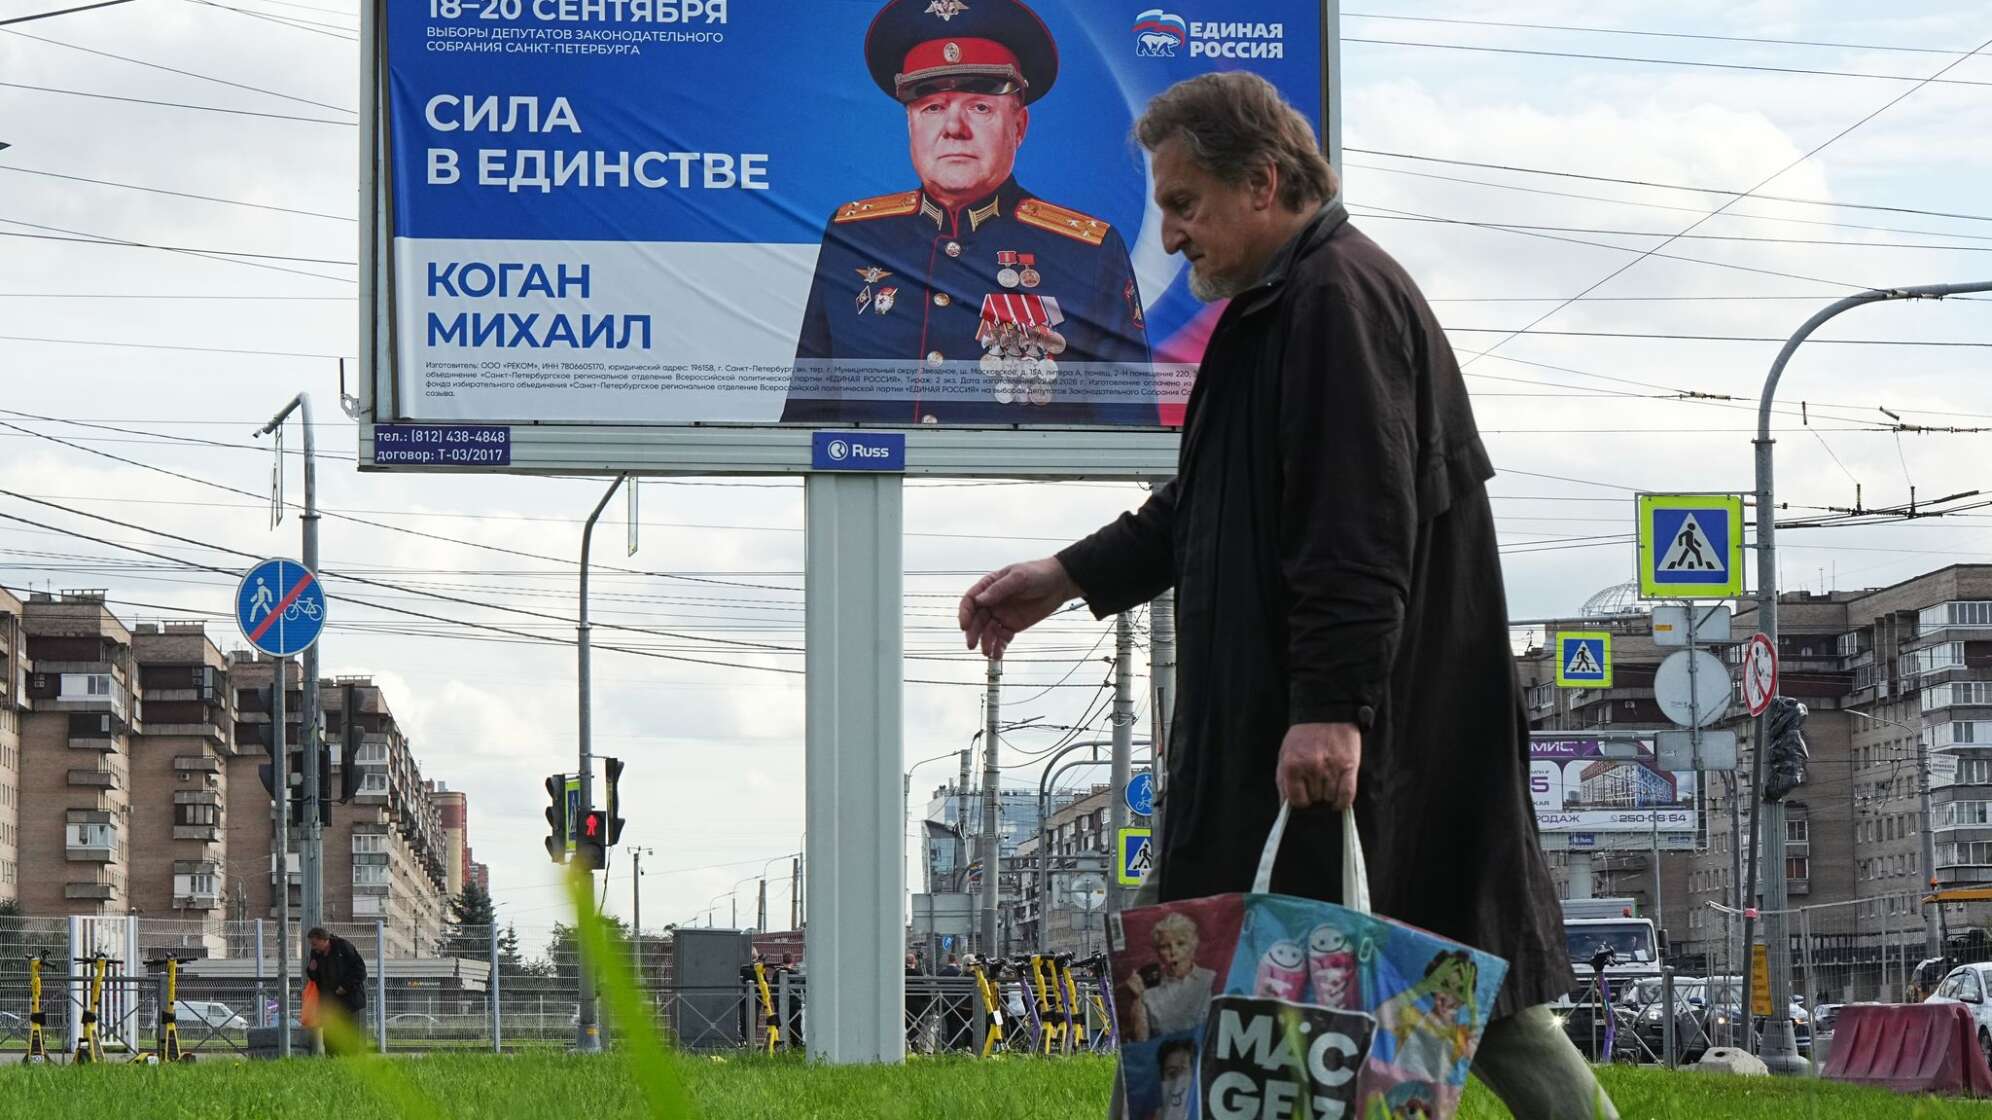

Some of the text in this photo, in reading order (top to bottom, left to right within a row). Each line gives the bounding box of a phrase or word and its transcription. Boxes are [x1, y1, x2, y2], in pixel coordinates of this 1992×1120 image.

[532, 0, 728, 24] СЕНТЯБРЯ
[427, 27, 724, 43] ВЫБОРЫ ДЕПУТАТОВ ЗАКОНОДАТЕЛЬНОГО
[1190, 22, 1283, 40] ЕДИНАЯ
[427, 41, 641, 55] СОБРАНИЯ САНКТ-ПЕТЕРБУРГА
[1190, 41, 1283, 59] РОССИЯ
[425, 94, 582, 134] СИЛА
[427, 148, 769, 194] В ЕДИНСТВЕ
[427, 262, 590, 299] КОГАН
[427, 312, 652, 350] МИХАИЛ
[481, 362, 501, 370] ООО
[542, 362, 559, 370] ИНН
[608, 364, 661, 373] юридический
[834, 367, 896, 375] Муниципальный
[897, 368, 918, 376] округ
[425, 381, 451, 389] фонда
[661, 383, 716, 391] региональное
[717, 383, 758, 391] отделение
[573, 373, 629, 381] региональное
[675, 373, 735, 381] Всероссийской
[738, 374, 791, 382] политической
[960, 376, 980, 384] Дата
[377, 429, 505, 443] тел.: (812) 438-4848
[377, 448, 503, 463] договор: Т-03/2017
[852, 444, 889, 458] Russ
